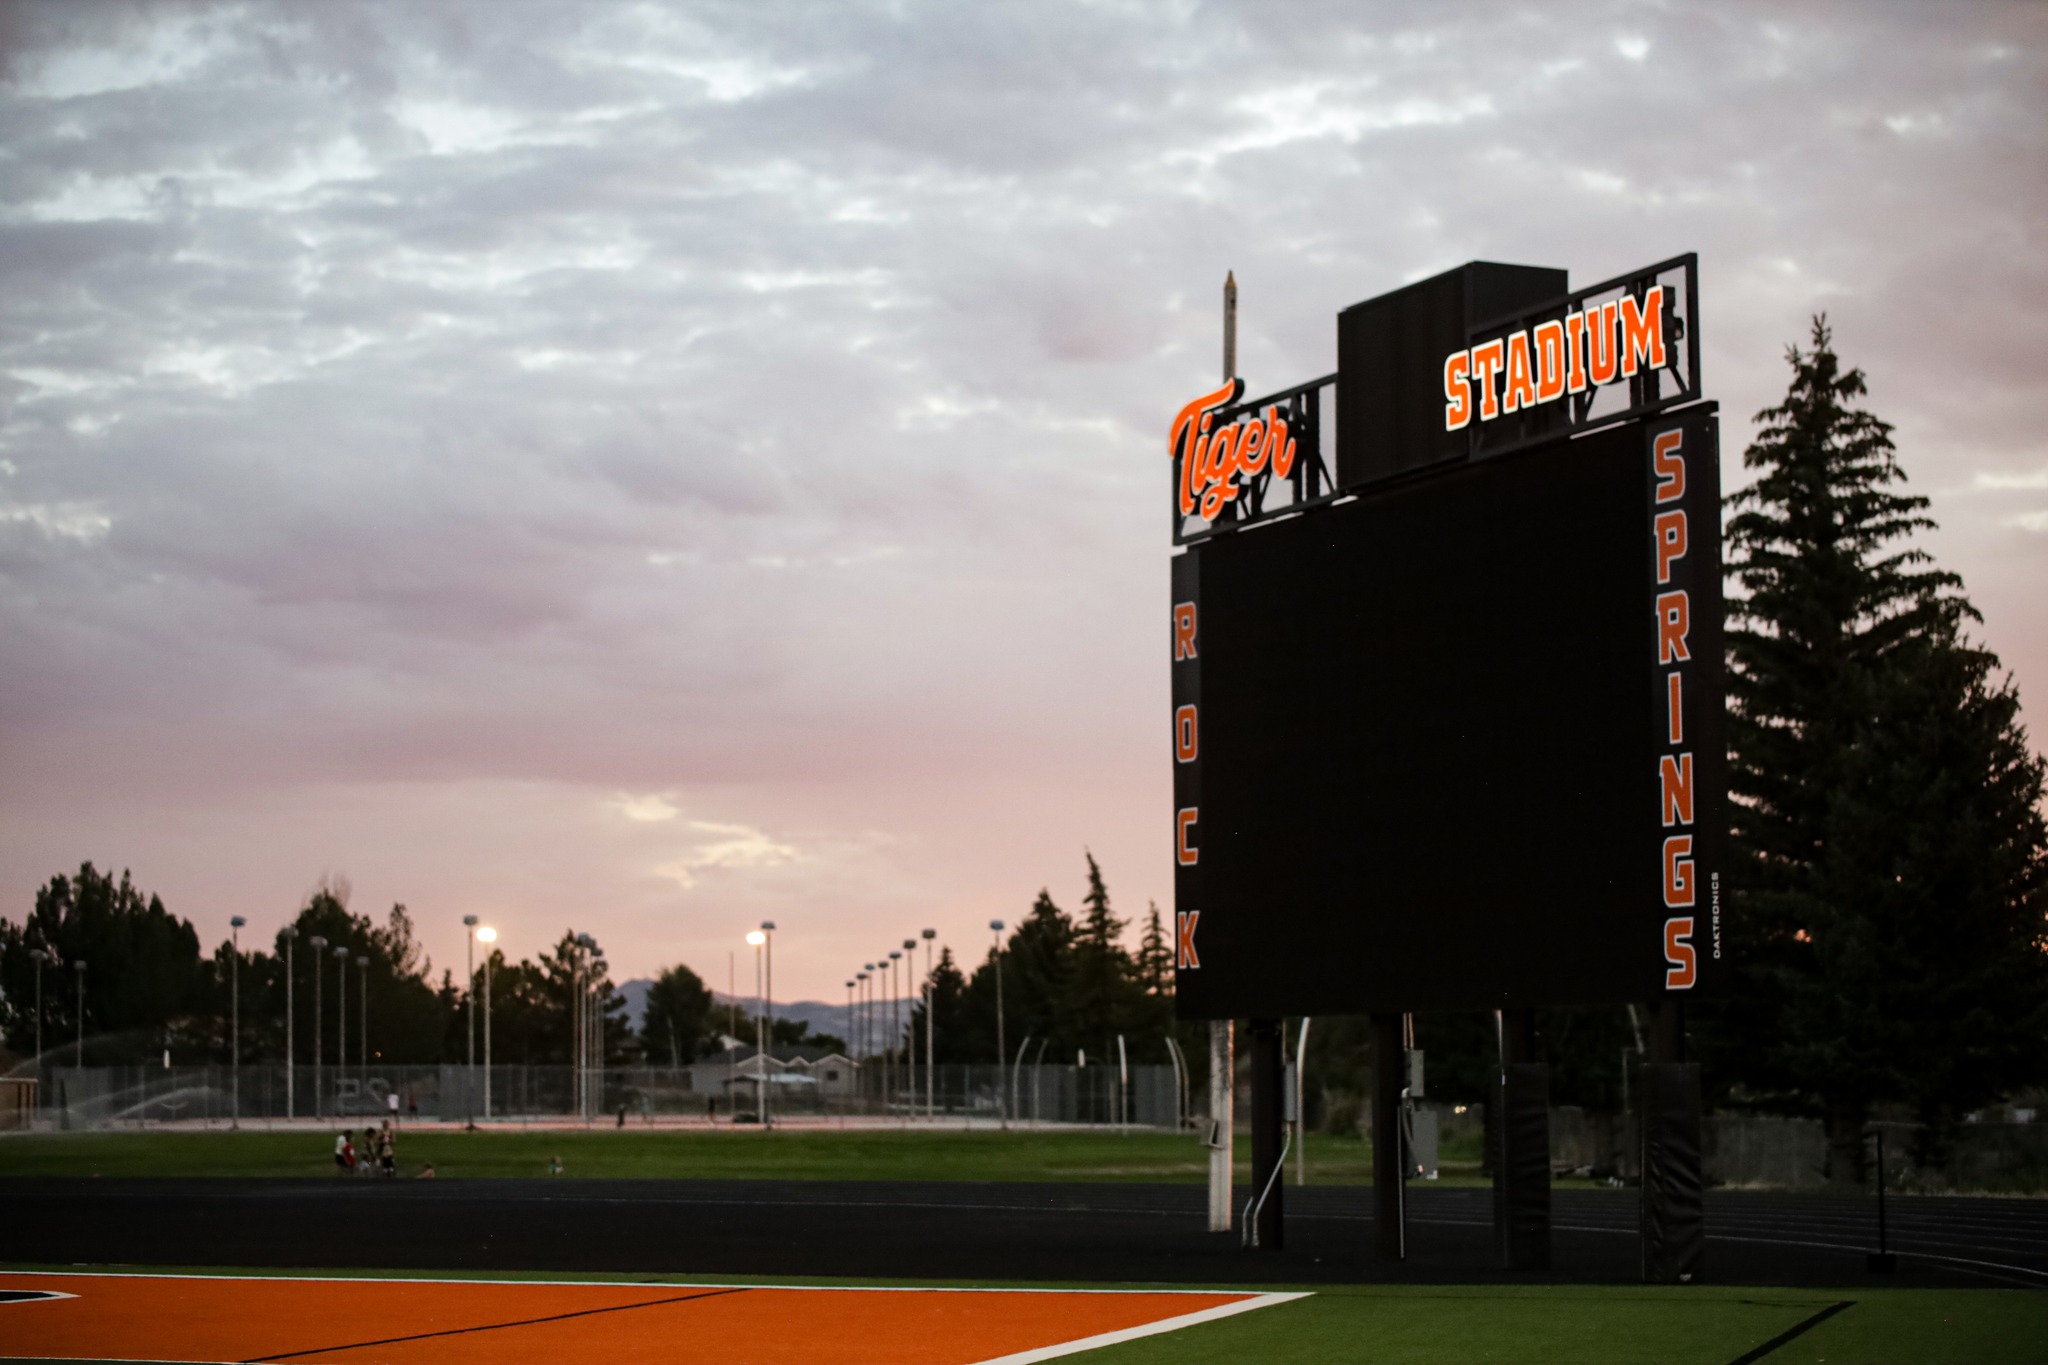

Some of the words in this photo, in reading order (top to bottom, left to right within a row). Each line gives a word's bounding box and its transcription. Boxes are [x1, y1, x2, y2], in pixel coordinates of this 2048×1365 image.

[1444, 284, 1666, 432] STADIUM
[1168, 377, 1297, 522] Tiger
[1653, 427, 1697, 990] SPRINGS
[1174, 601, 1200, 970] ROCK
[1711, 871, 1721, 959] DAKTRONICS
